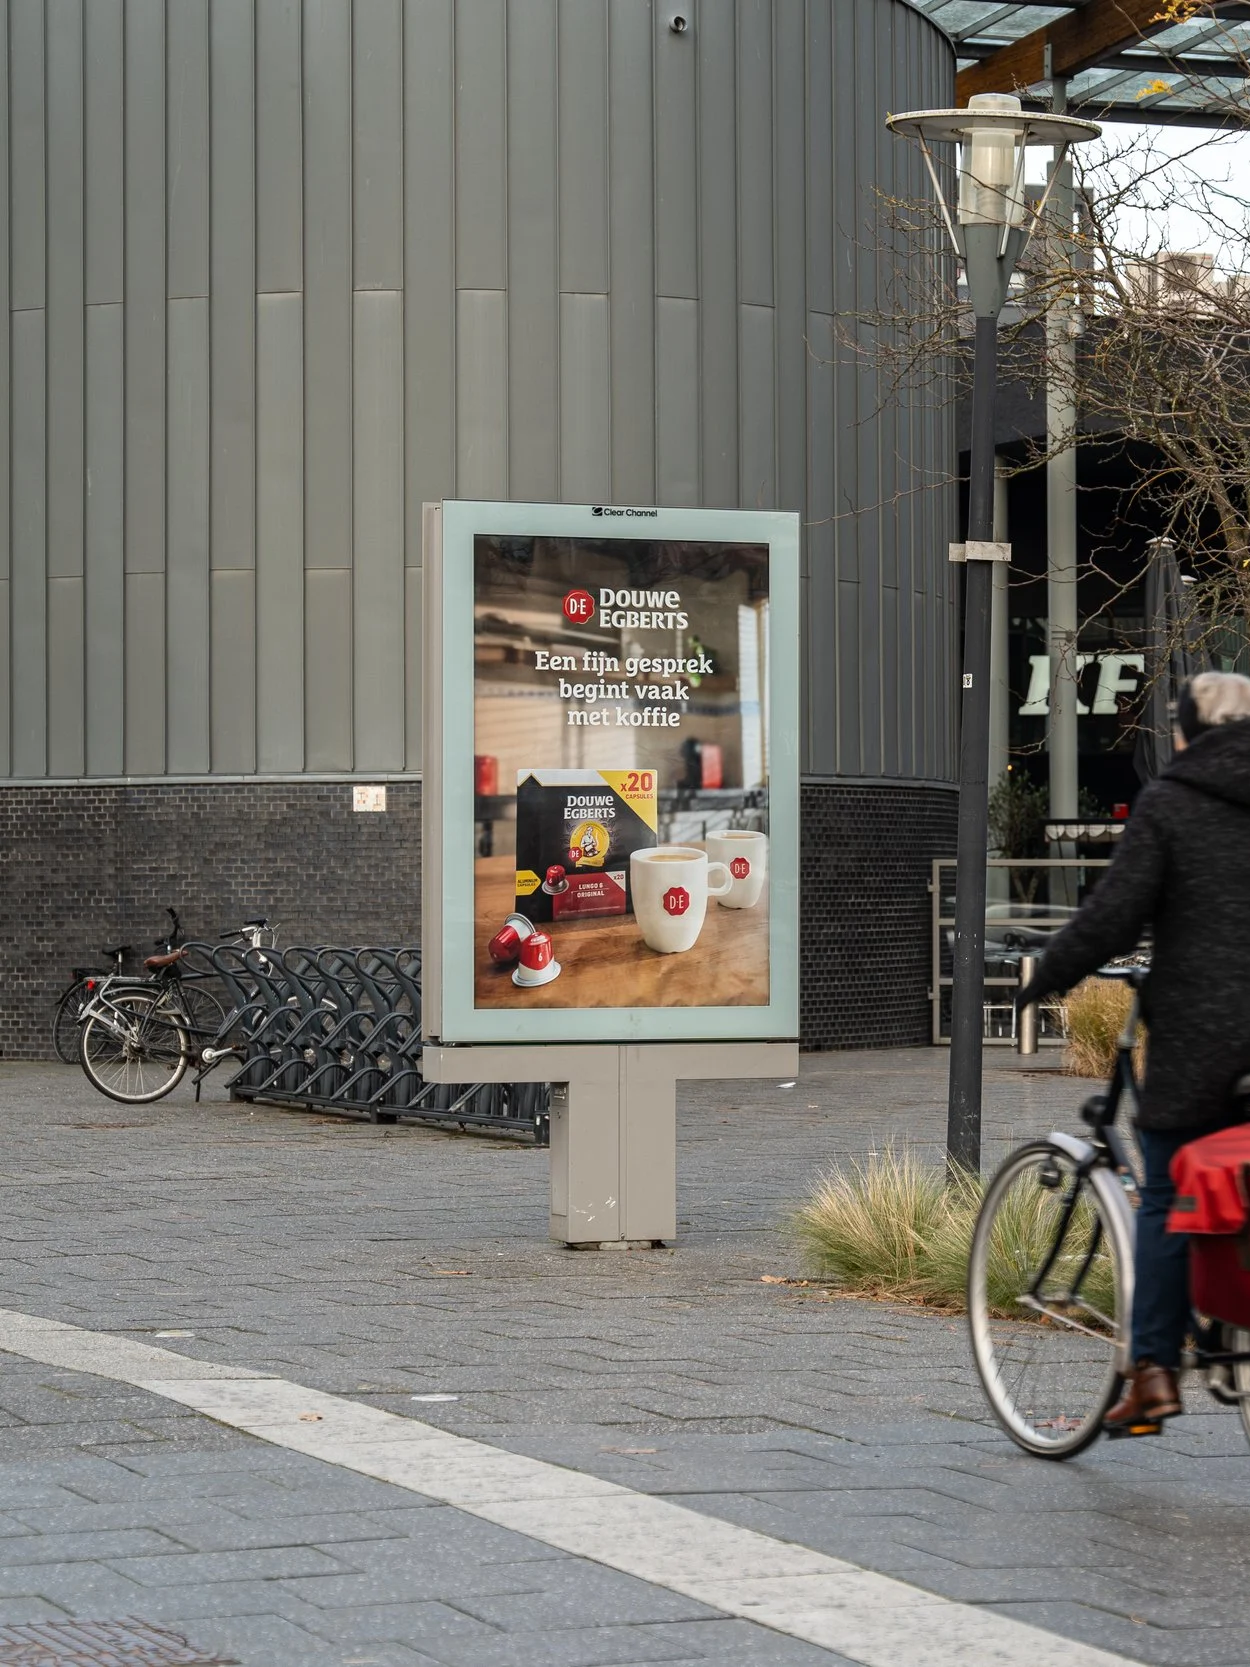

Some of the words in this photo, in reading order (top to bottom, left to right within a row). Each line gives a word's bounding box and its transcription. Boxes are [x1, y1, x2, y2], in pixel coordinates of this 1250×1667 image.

[603, 507, 625, 516] Clear
[626, 508, 658, 517] Channel
[599, 609, 689, 630] EGBERTS
[535, 651, 578, 671] Een
[582, 652, 620, 677] fijn
[625, 654, 713, 678] gesprek
[559, 679, 629, 704] begint
[634, 681, 690, 701] vaak
[568, 709, 610, 727] met
[615, 707, 681, 728] koffie
[620, 772, 653, 792] x20
[564, 807, 616, 820] EGBERTS
[577, 890, 605, 898] ORIGINAL
[538, 953, 543, 962] 6
